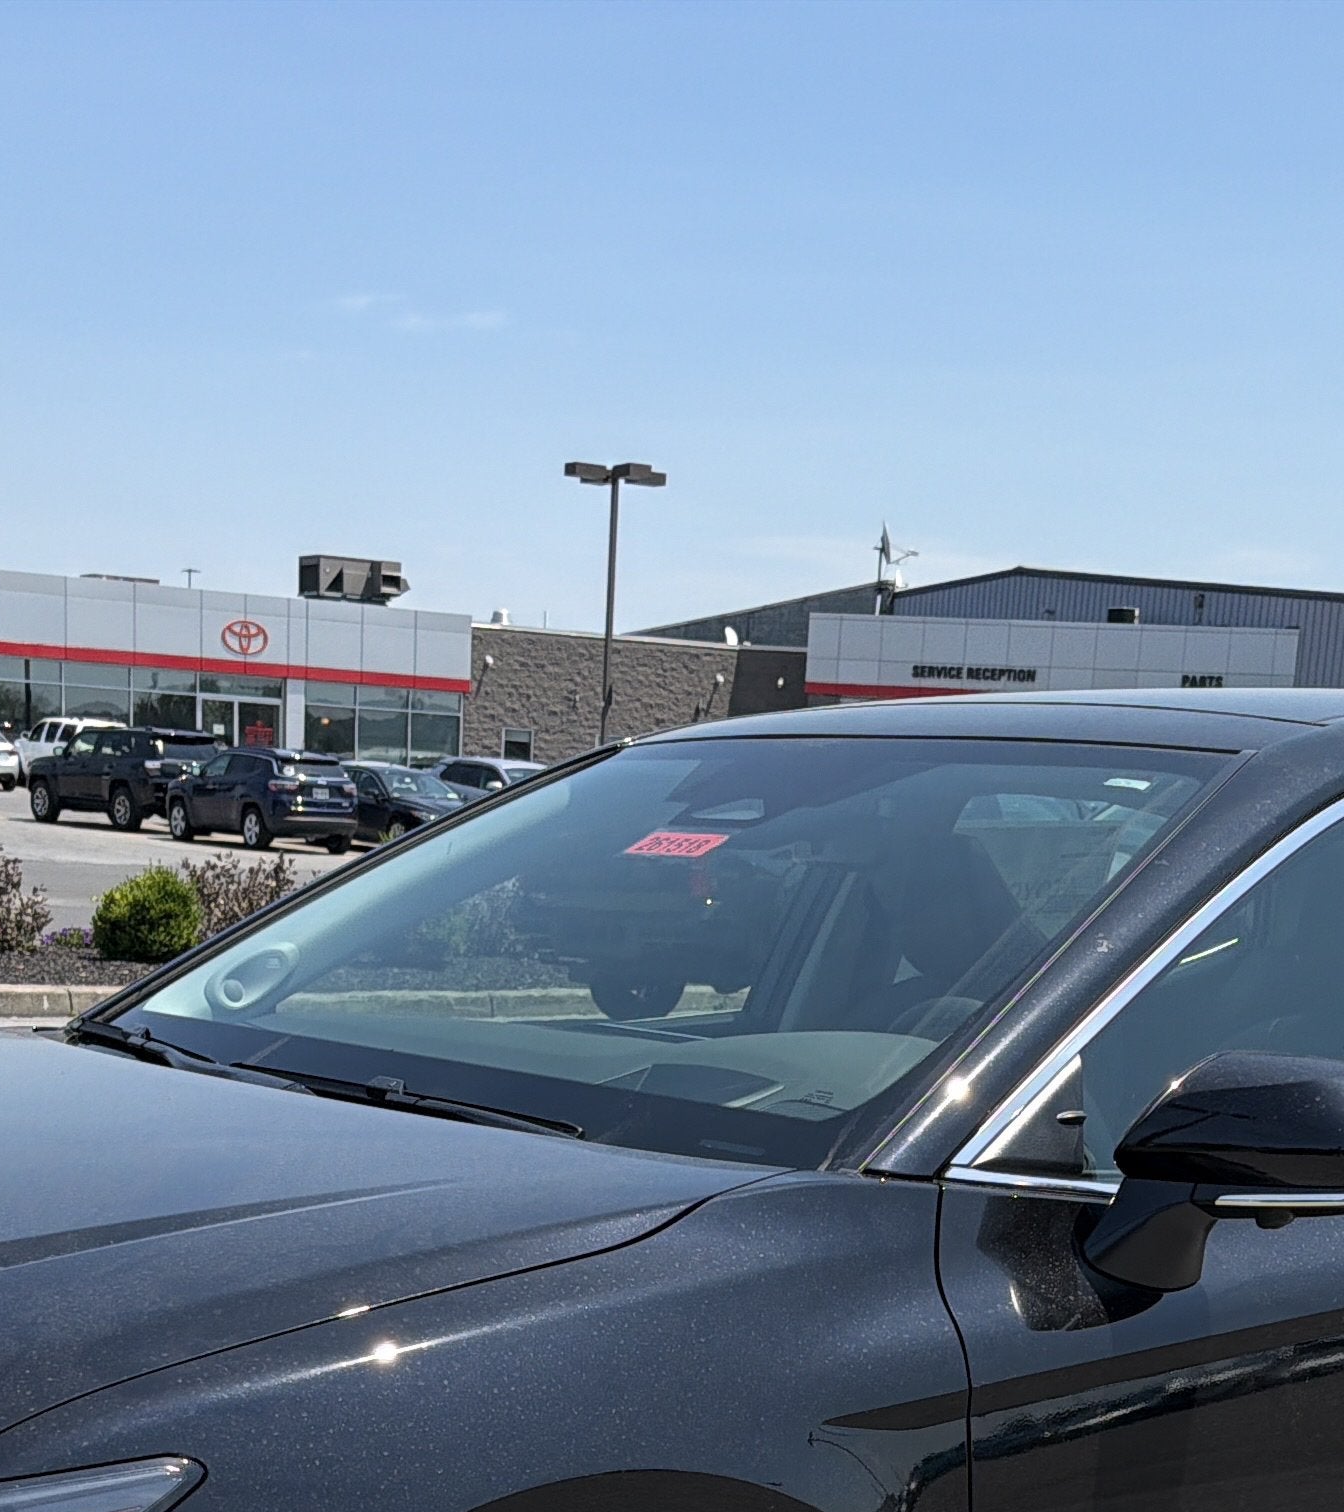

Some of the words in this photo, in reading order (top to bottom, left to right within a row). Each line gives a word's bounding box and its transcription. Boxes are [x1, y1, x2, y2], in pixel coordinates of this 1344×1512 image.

[912, 665, 963, 680] SERVICE
[966, 666, 1036, 683] RECEPTION
[1181, 674, 1224, 688] PARTS
